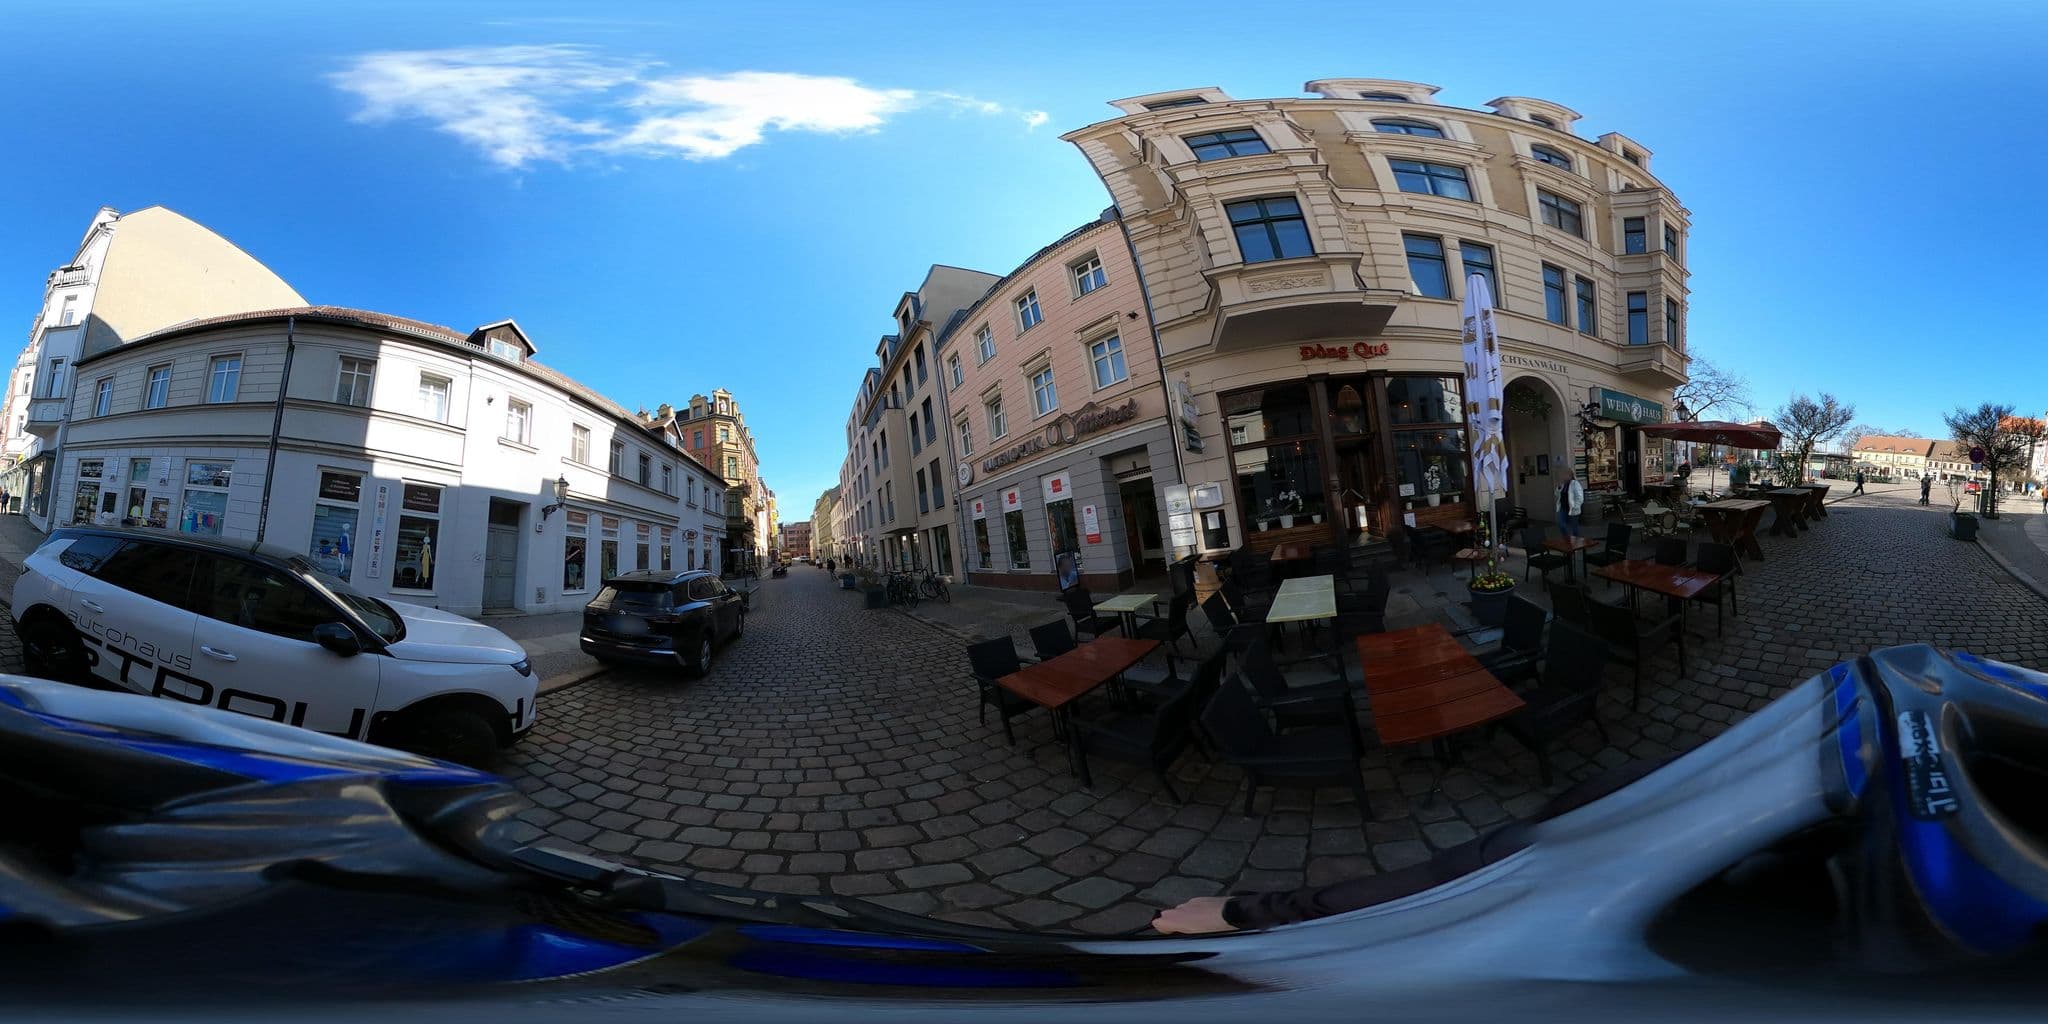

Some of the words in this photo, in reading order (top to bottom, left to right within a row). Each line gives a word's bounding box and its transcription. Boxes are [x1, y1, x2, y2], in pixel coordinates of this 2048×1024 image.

[1605, 397, 1631, 414] WEIN
[1642, 407, 1661, 420] HAUS
[67, 609, 192, 671] autohaus
